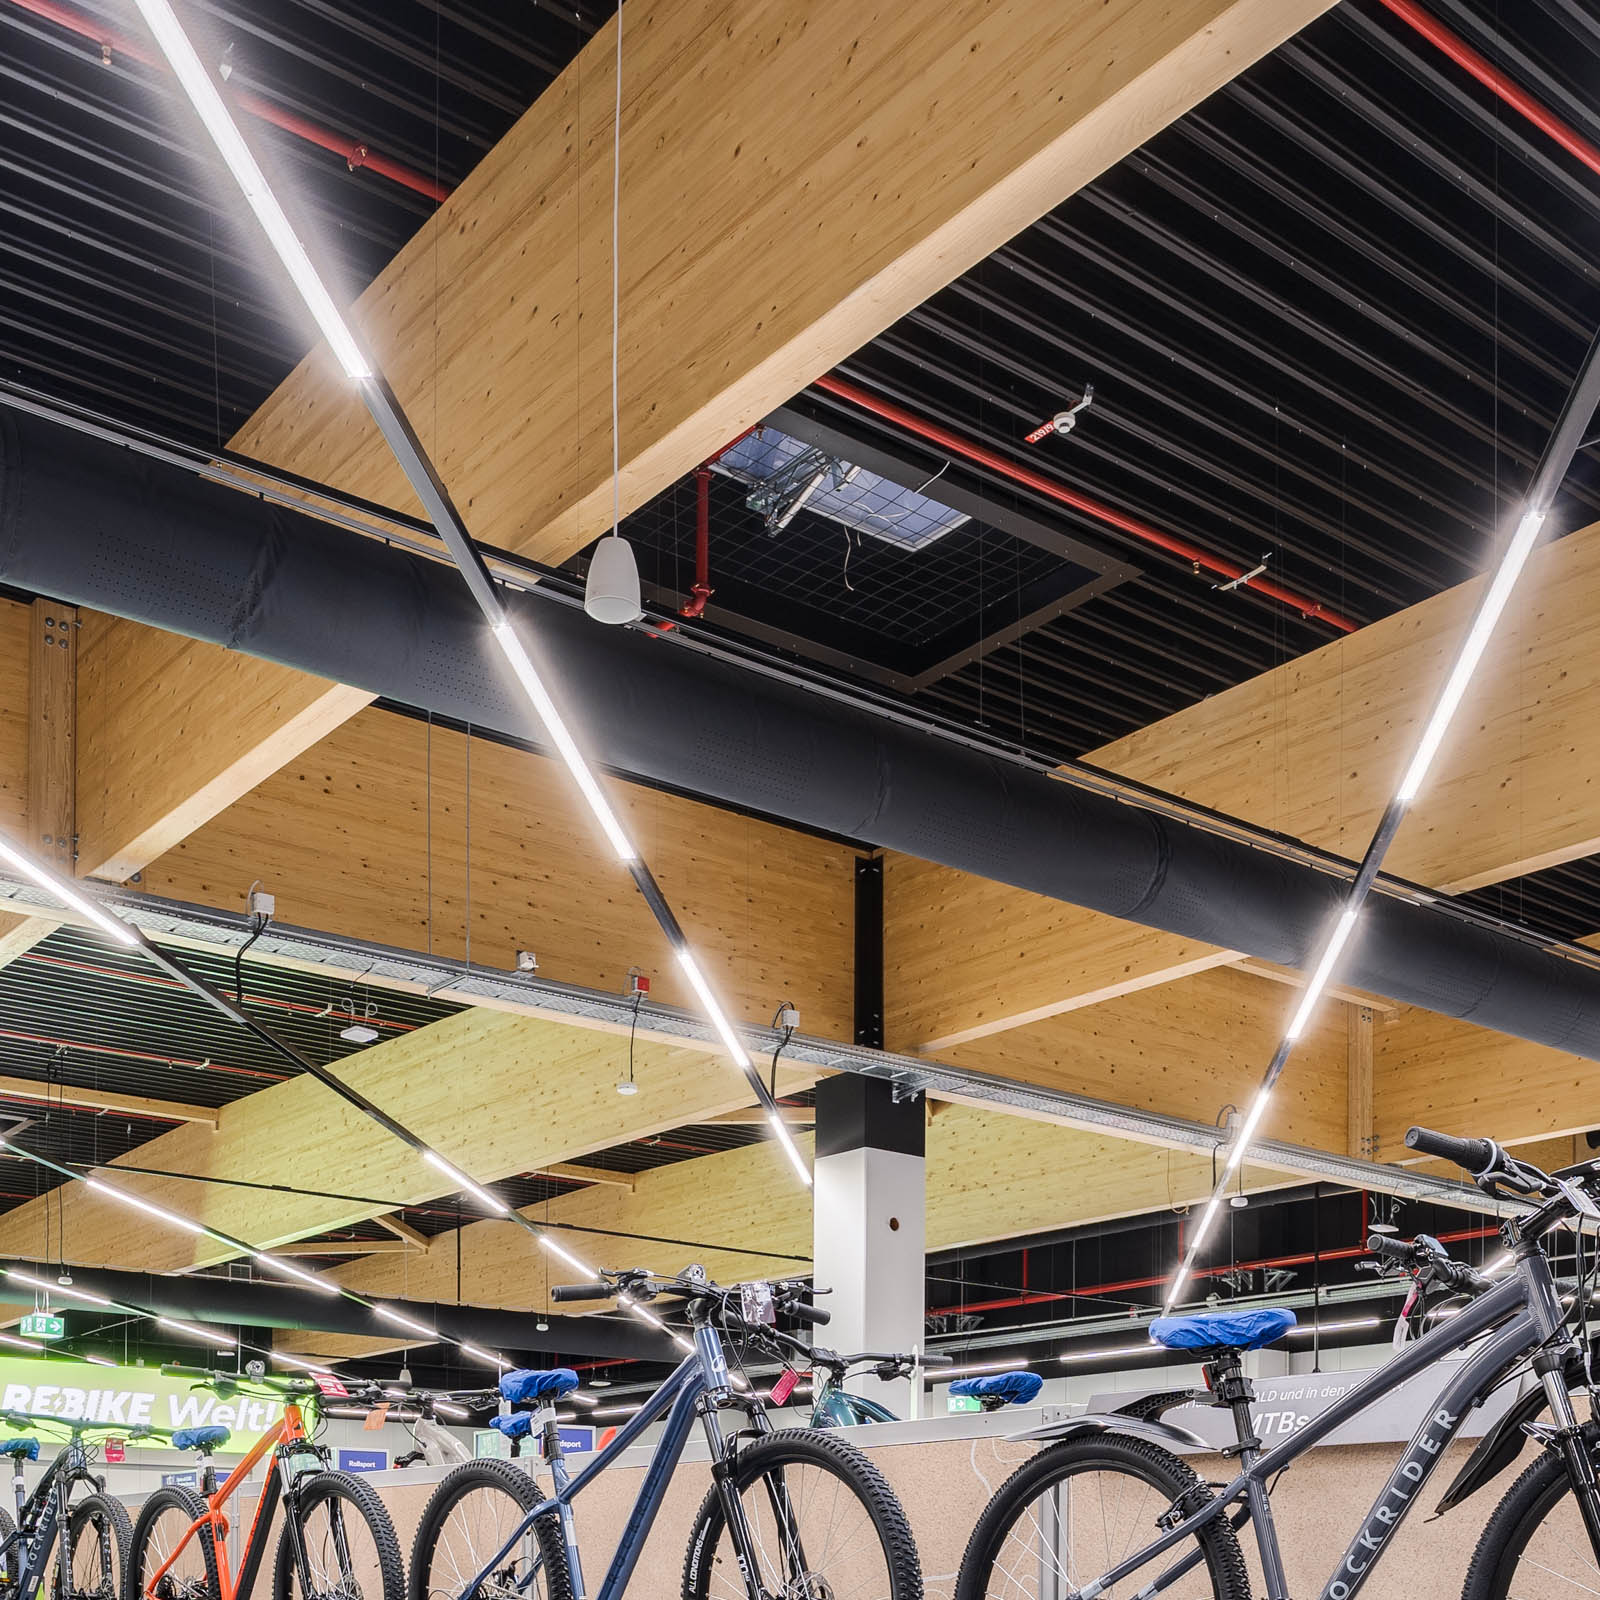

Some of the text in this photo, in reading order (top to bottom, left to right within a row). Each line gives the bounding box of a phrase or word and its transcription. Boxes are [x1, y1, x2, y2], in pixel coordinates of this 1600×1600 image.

[1280, 1388, 1304, 1401] und
[1307, 1386, 1319, 1399] in
[1320, 1384, 1346, 1398] den
[168, 1394, 278, 1432] Welt!
[688, 1539, 704, 1594] CONDITIONS ALL
